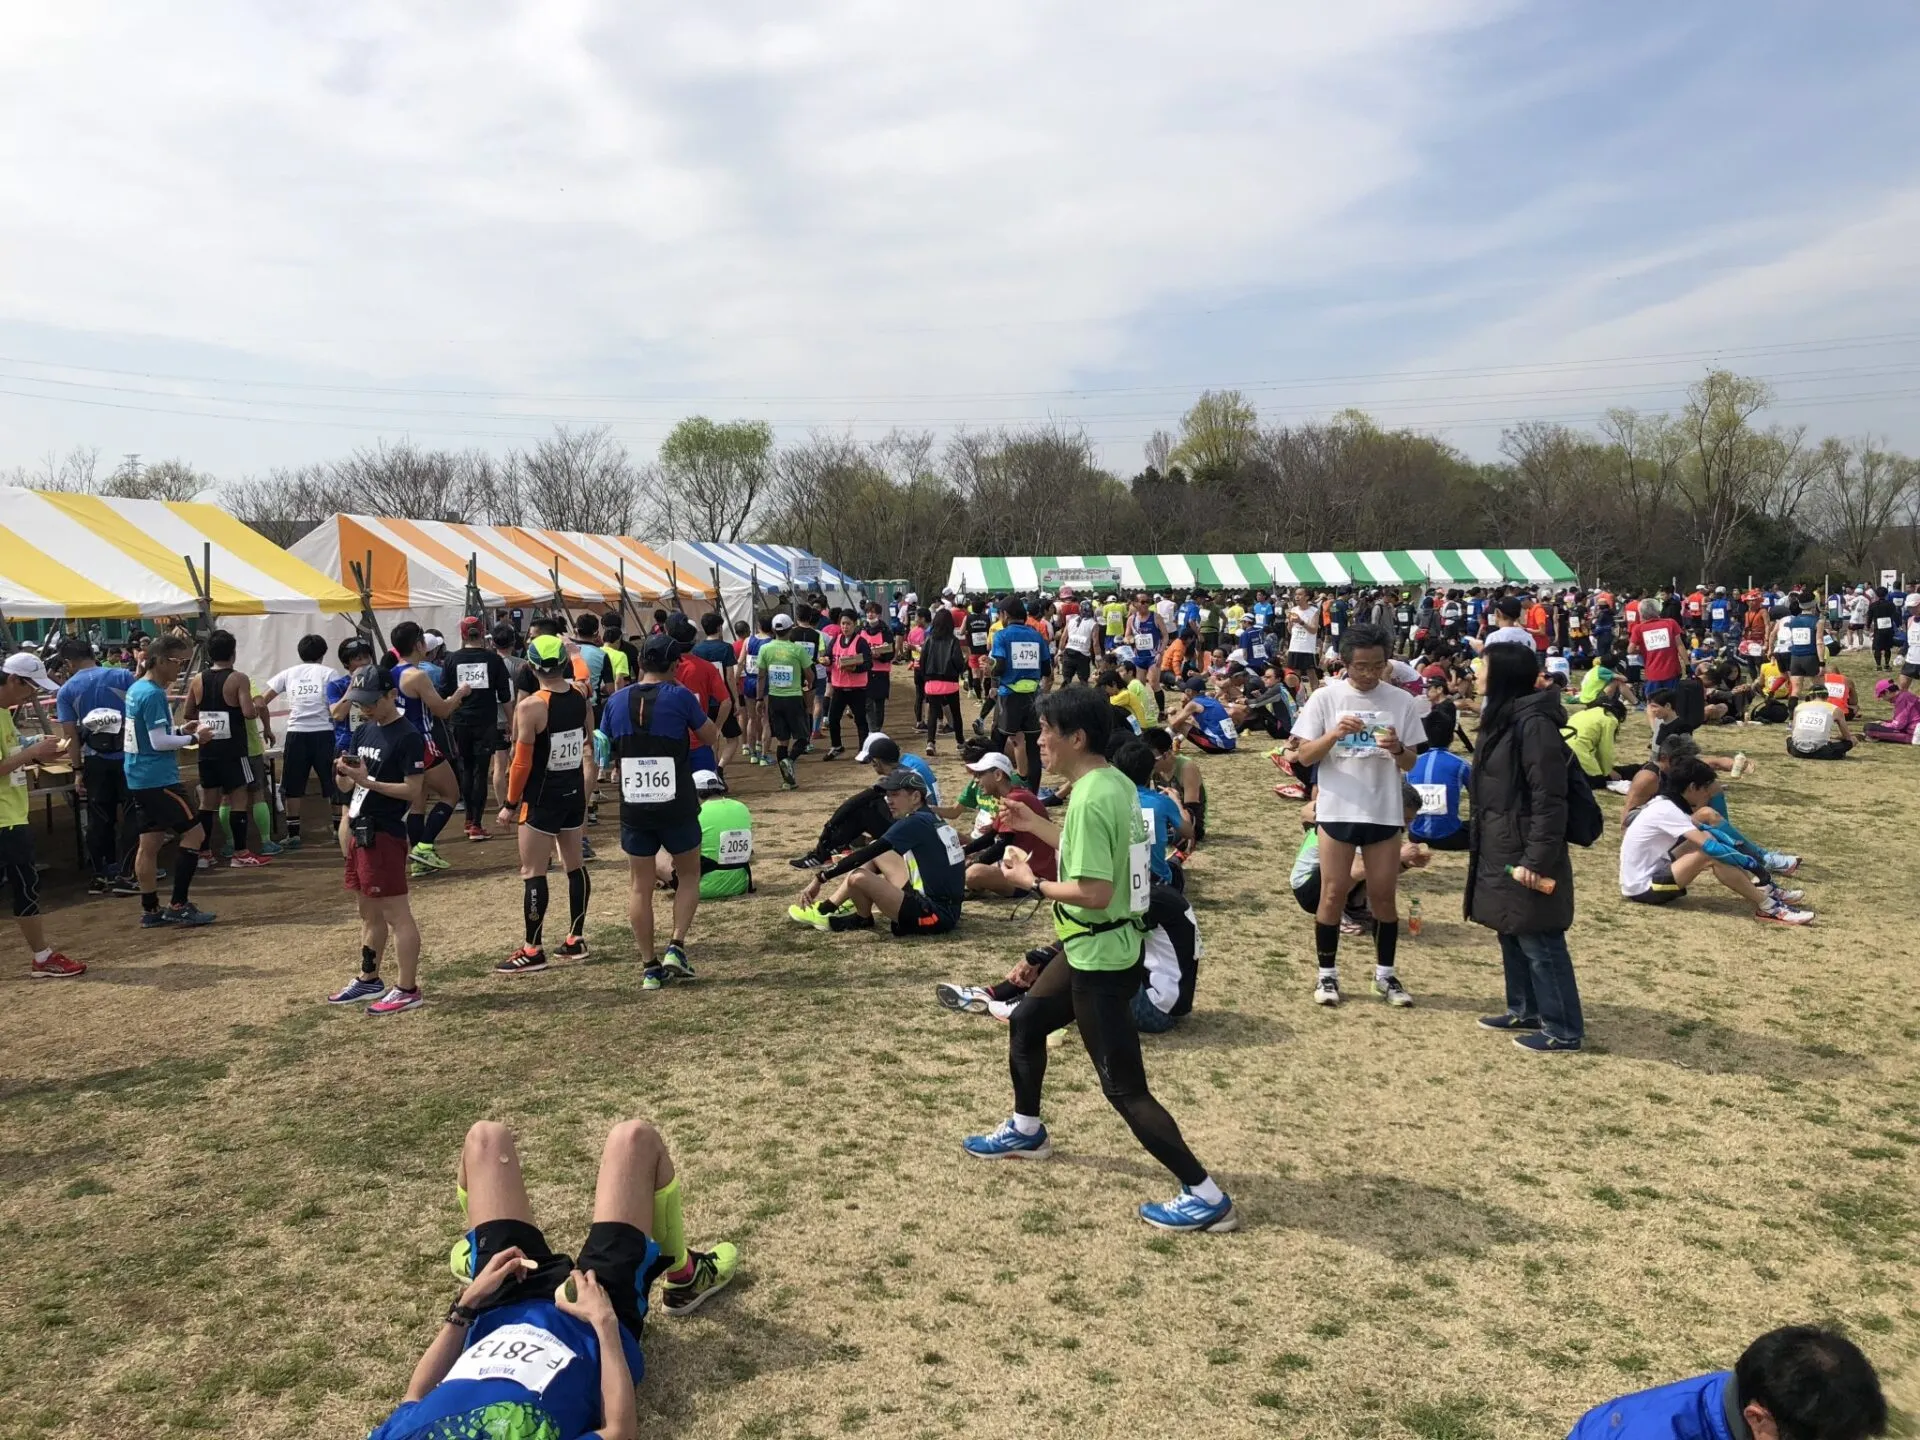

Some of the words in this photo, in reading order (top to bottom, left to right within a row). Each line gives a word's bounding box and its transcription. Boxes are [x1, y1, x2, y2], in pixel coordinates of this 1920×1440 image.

[1020, 651, 1038, 660] 4794
[465, 672, 485, 681] 2564
[774, 672, 791, 681] 5853
[298, 685, 319, 695] 2592
[1805, 716, 1824, 726] 2259
[552, 750, 557, 759] E
[560, 741, 581, 758] 2161
[624, 777, 631, 788] F
[635, 771, 670, 788] 3166
[720, 845, 726, 853] E
[727, 840, 749, 853] 2056
[1133, 874, 1141, 890] D
[471, 1339, 544, 1364] 2813
[546, 1354, 563, 1373] F
